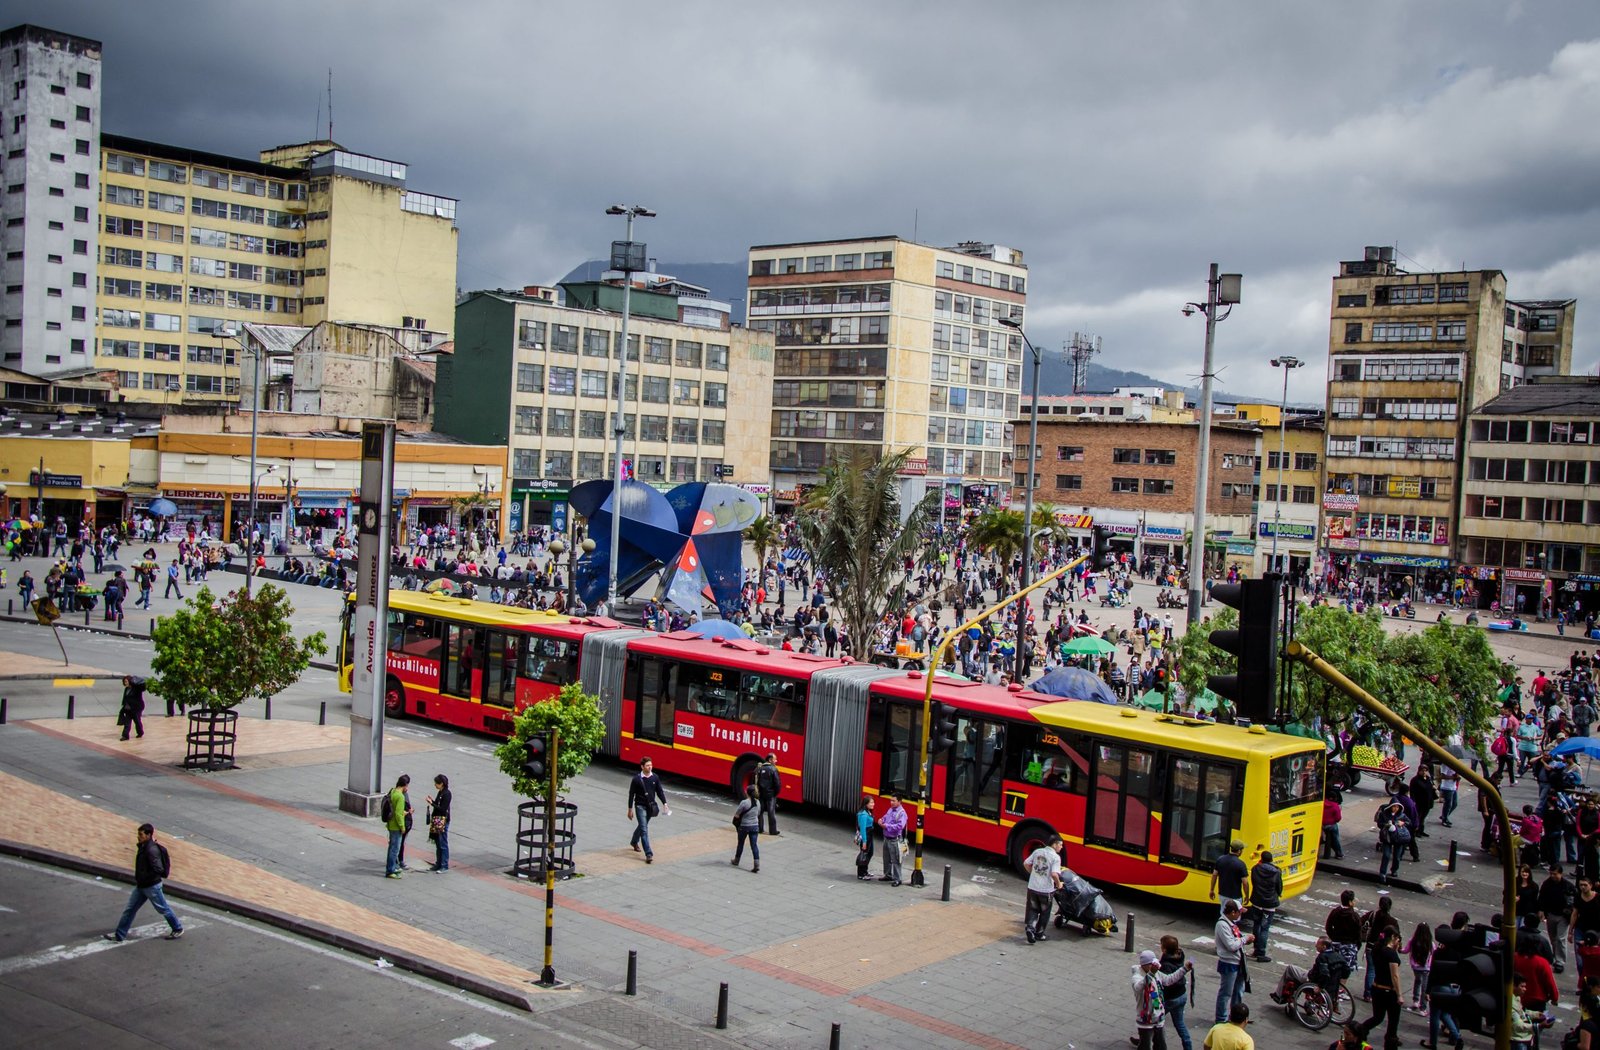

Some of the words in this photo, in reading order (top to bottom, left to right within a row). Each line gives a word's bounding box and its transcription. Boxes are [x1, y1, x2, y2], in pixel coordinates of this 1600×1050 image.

[163, 490, 224, 499] LIBRERIA
[232, 492, 277, 500] STDIO
[1146, 527, 1182, 535] DROGUERIA
[366, 620, 374, 673] Avenida
[709, 672, 723, 681] J23
[710, 723, 789, 753] TransMilenio
[1042, 733, 1059, 745] J23
